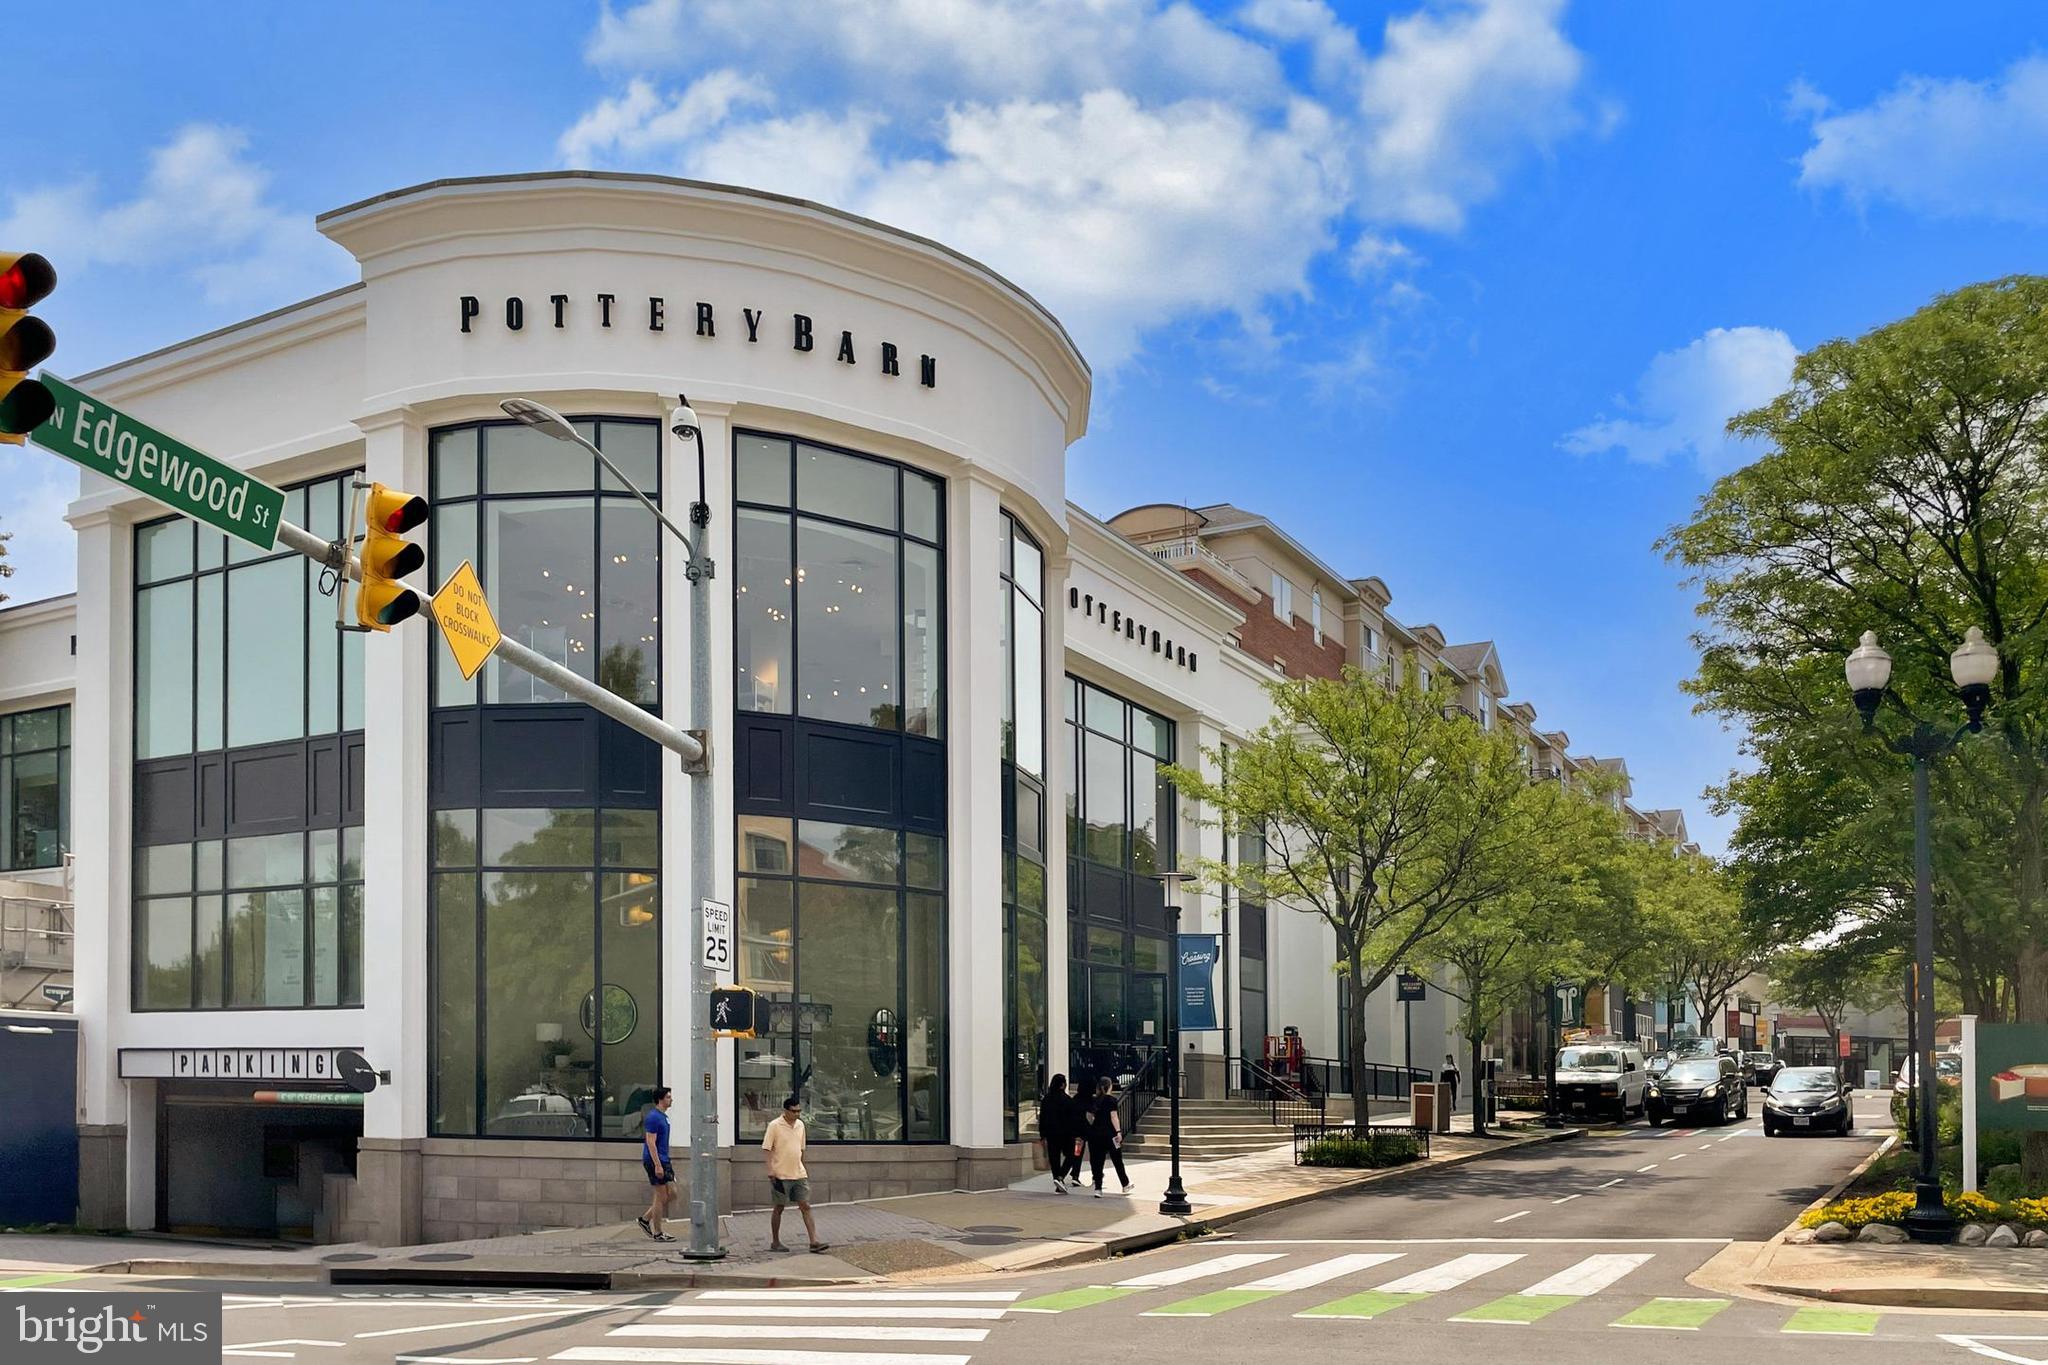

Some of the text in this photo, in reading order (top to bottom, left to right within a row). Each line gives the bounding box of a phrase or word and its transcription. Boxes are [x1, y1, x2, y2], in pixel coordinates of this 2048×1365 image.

[49, 400, 270, 528] N Edgewood St
[453, 583, 482, 607] DO NOT
[456, 602, 480, 624] BLOCK
[443, 615, 491, 648] CROSSWALKS
[1070, 587, 1197, 673] OTTERYBARN
[705, 907, 728, 922] SPEED
[707, 922, 725, 935] LIMIT
[706, 936, 728, 963] 25
[180, 1054, 324, 1074] PARKING
